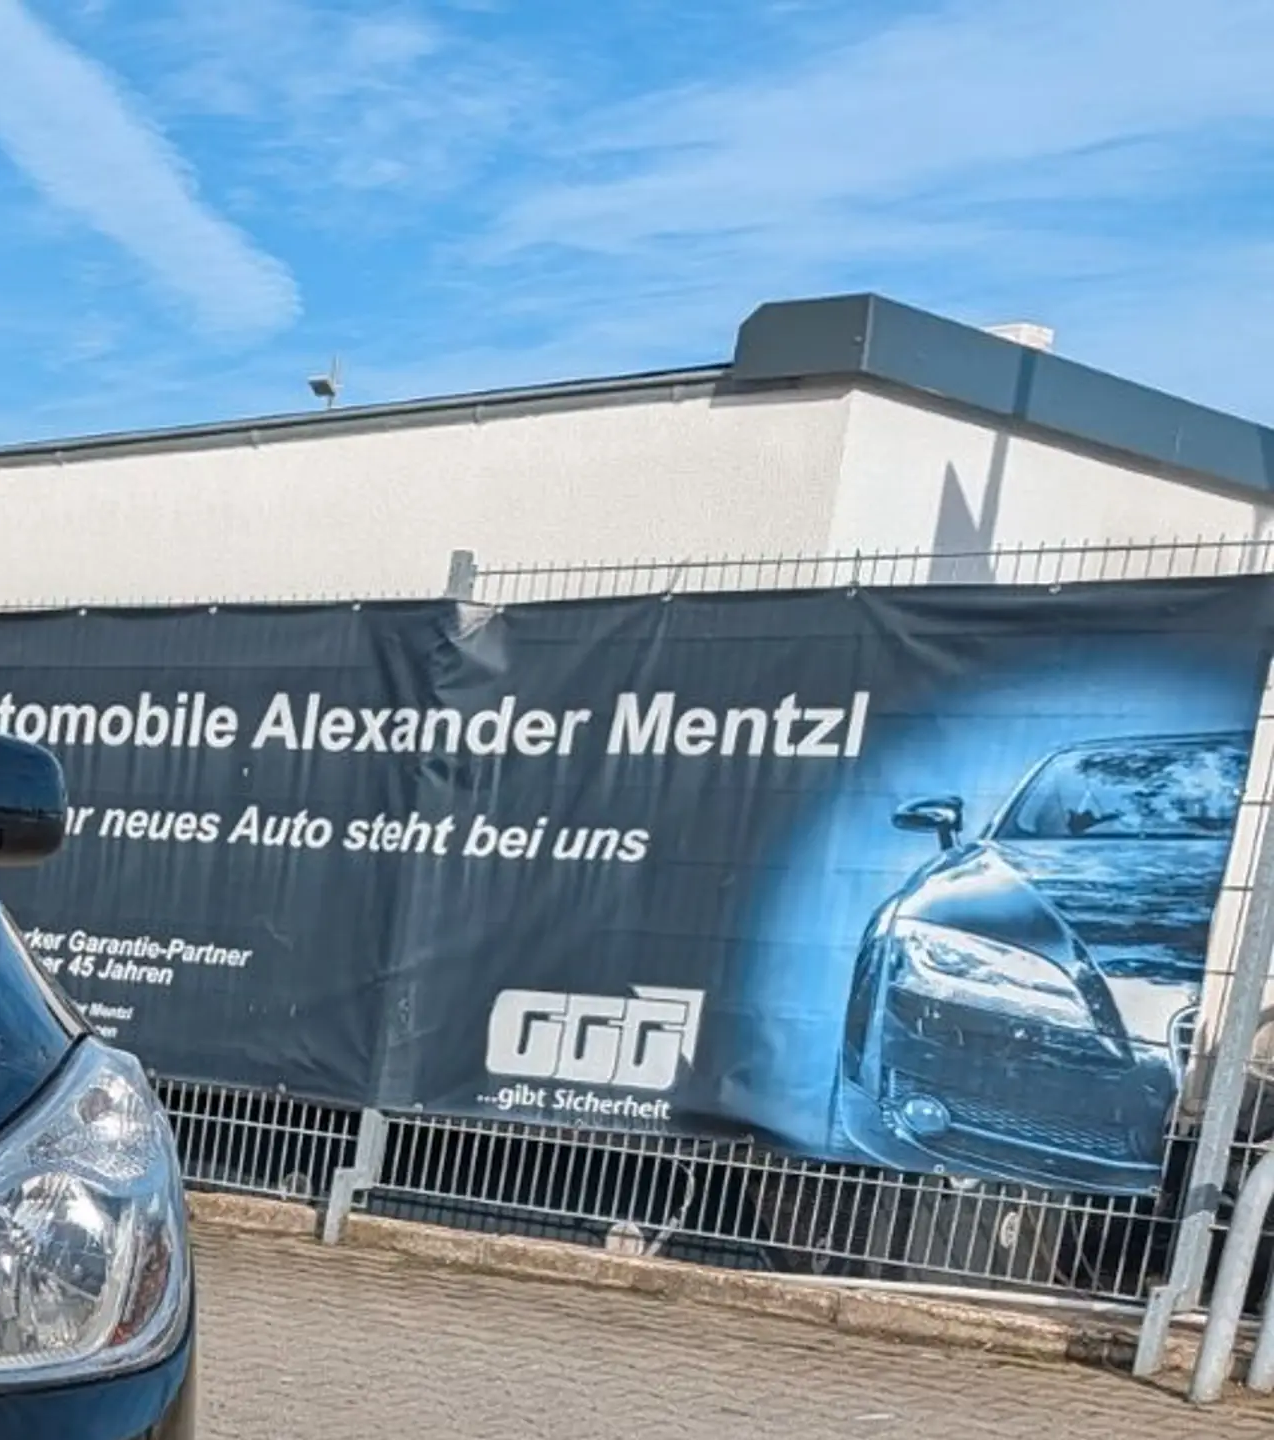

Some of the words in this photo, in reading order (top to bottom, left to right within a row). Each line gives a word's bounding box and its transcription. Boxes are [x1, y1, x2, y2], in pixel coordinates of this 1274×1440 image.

[251, 692, 592, 756] Alexander
[607, 691, 870, 757] Mentzl
[100, 808, 220, 842] neues
[227, 805, 333, 848] Auto
[343, 810, 455, 855] steht
[462, 814, 548, 859] bei
[552, 826, 650, 863] uns
[68, 930, 253, 968] Garantie-Partner
[68, 955, 95, 978] 45
[98, 958, 174, 985] Jahren
[485, 988, 688, 1092] GGG
[552, 1088, 672, 1120] Sicherheit
